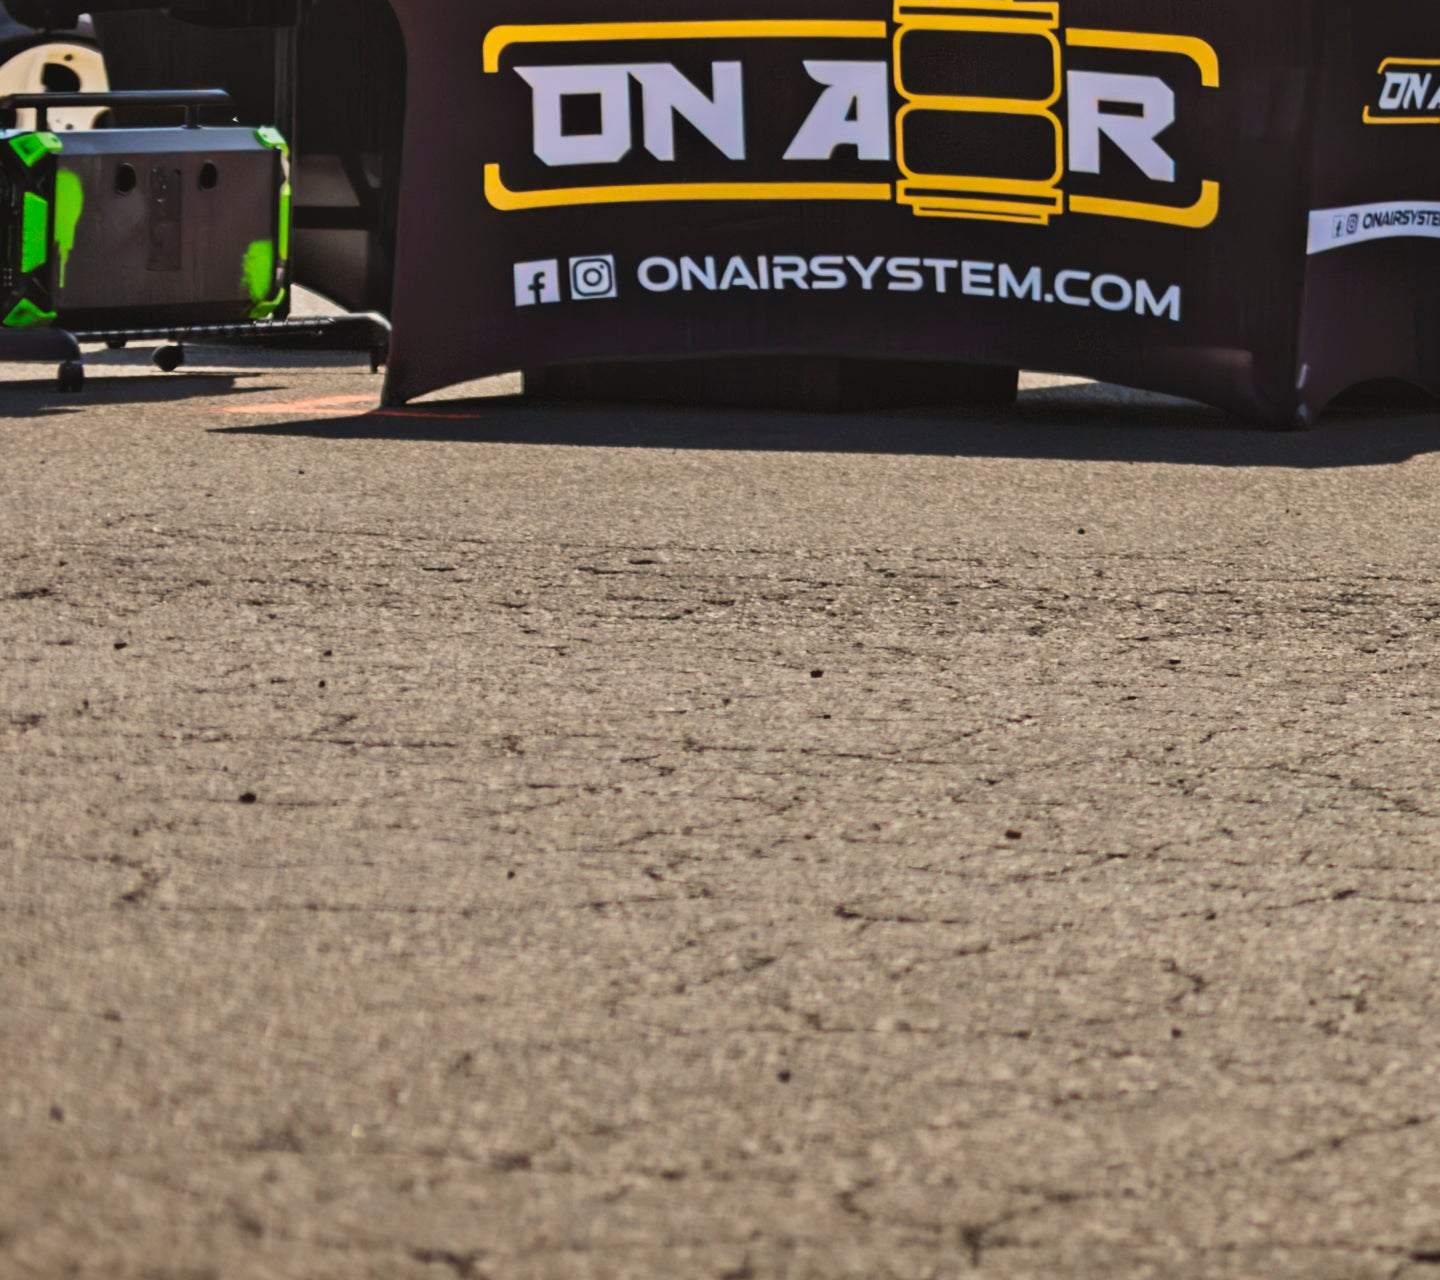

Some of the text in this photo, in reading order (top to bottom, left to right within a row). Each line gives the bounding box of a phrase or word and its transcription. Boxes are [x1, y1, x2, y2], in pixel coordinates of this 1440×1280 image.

[513, 59, 746, 168] ON
[1378, 71, 1432, 110] ON
[636, 254, 1182, 322] ONAIRSYSTEM.COM
